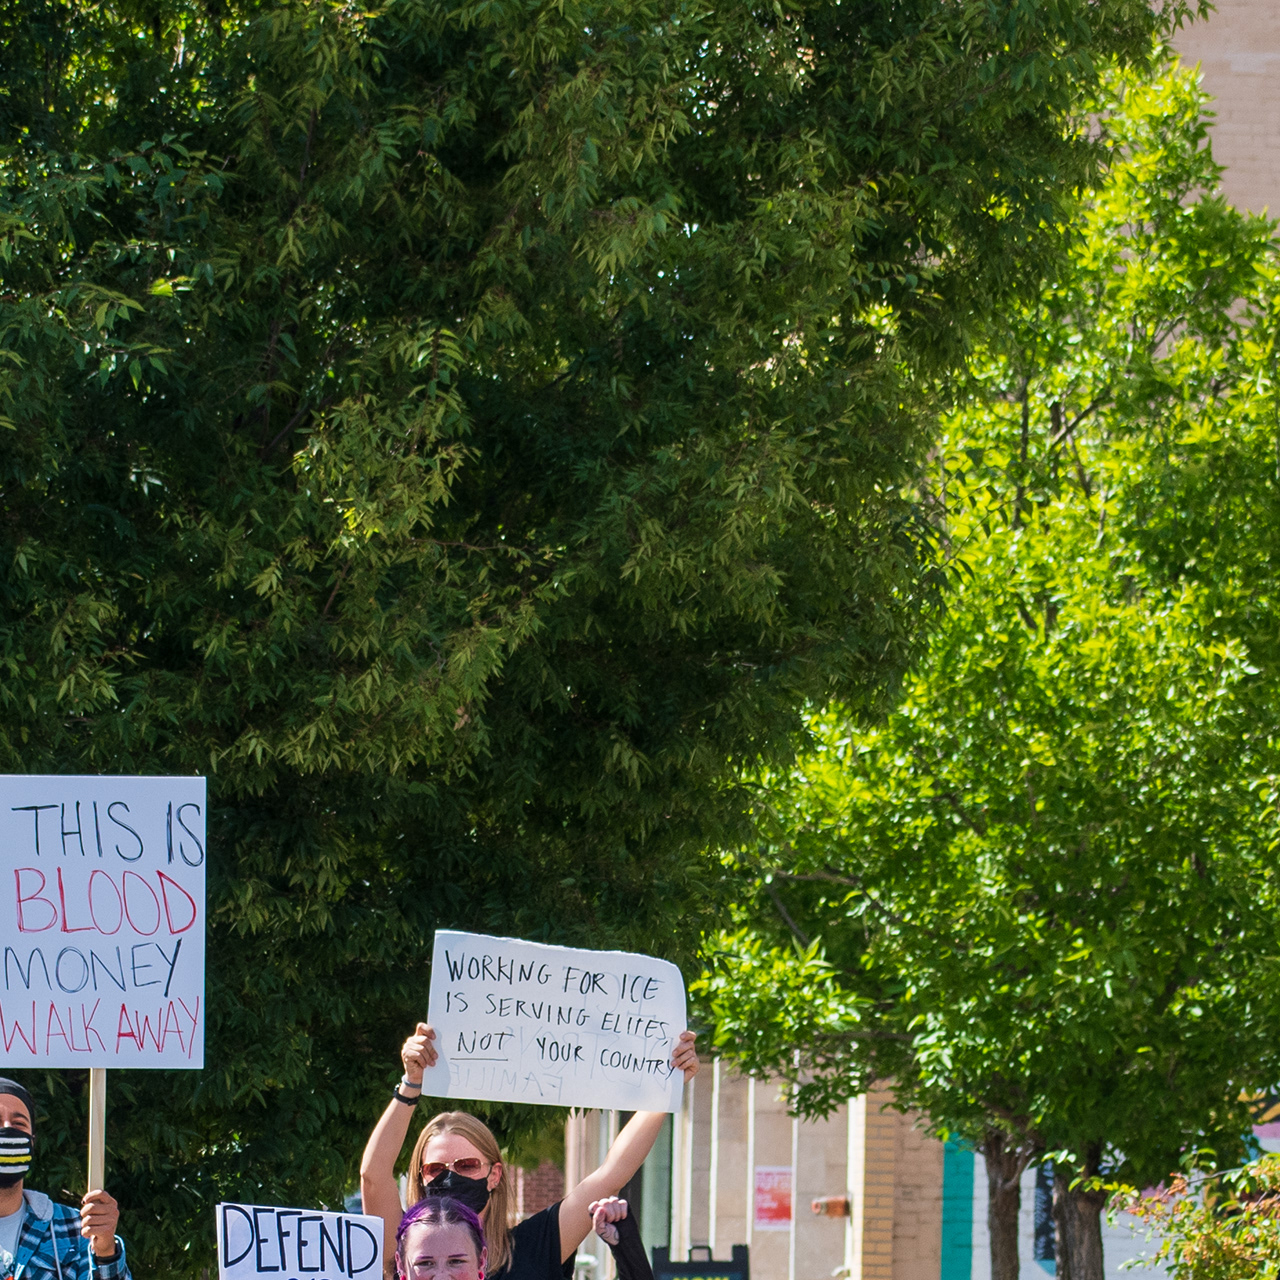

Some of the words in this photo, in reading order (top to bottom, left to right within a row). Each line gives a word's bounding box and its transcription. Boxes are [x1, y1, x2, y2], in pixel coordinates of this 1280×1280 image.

[12, 800, 144, 862] THIS
[166, 800, 204, 867] IS
[13, 866, 197, 936] BLOOD
[4, 937, 183, 998] MONEY
[445, 950, 552, 986] WORKING
[563, 966, 608, 996] FOR
[621, 973, 660, 1003] ICE
[116, 996, 200, 1060] AWAY
[446, 991, 469, 1013] IS
[485, 993, 591, 1027] SERVING
[457, 1030, 515, 1054] NOT
[536, 1037, 585, 1063] YOUR
[600, 1048, 676, 1081] COUNTRY
[223, 1205, 378, 1279] DEFEND
